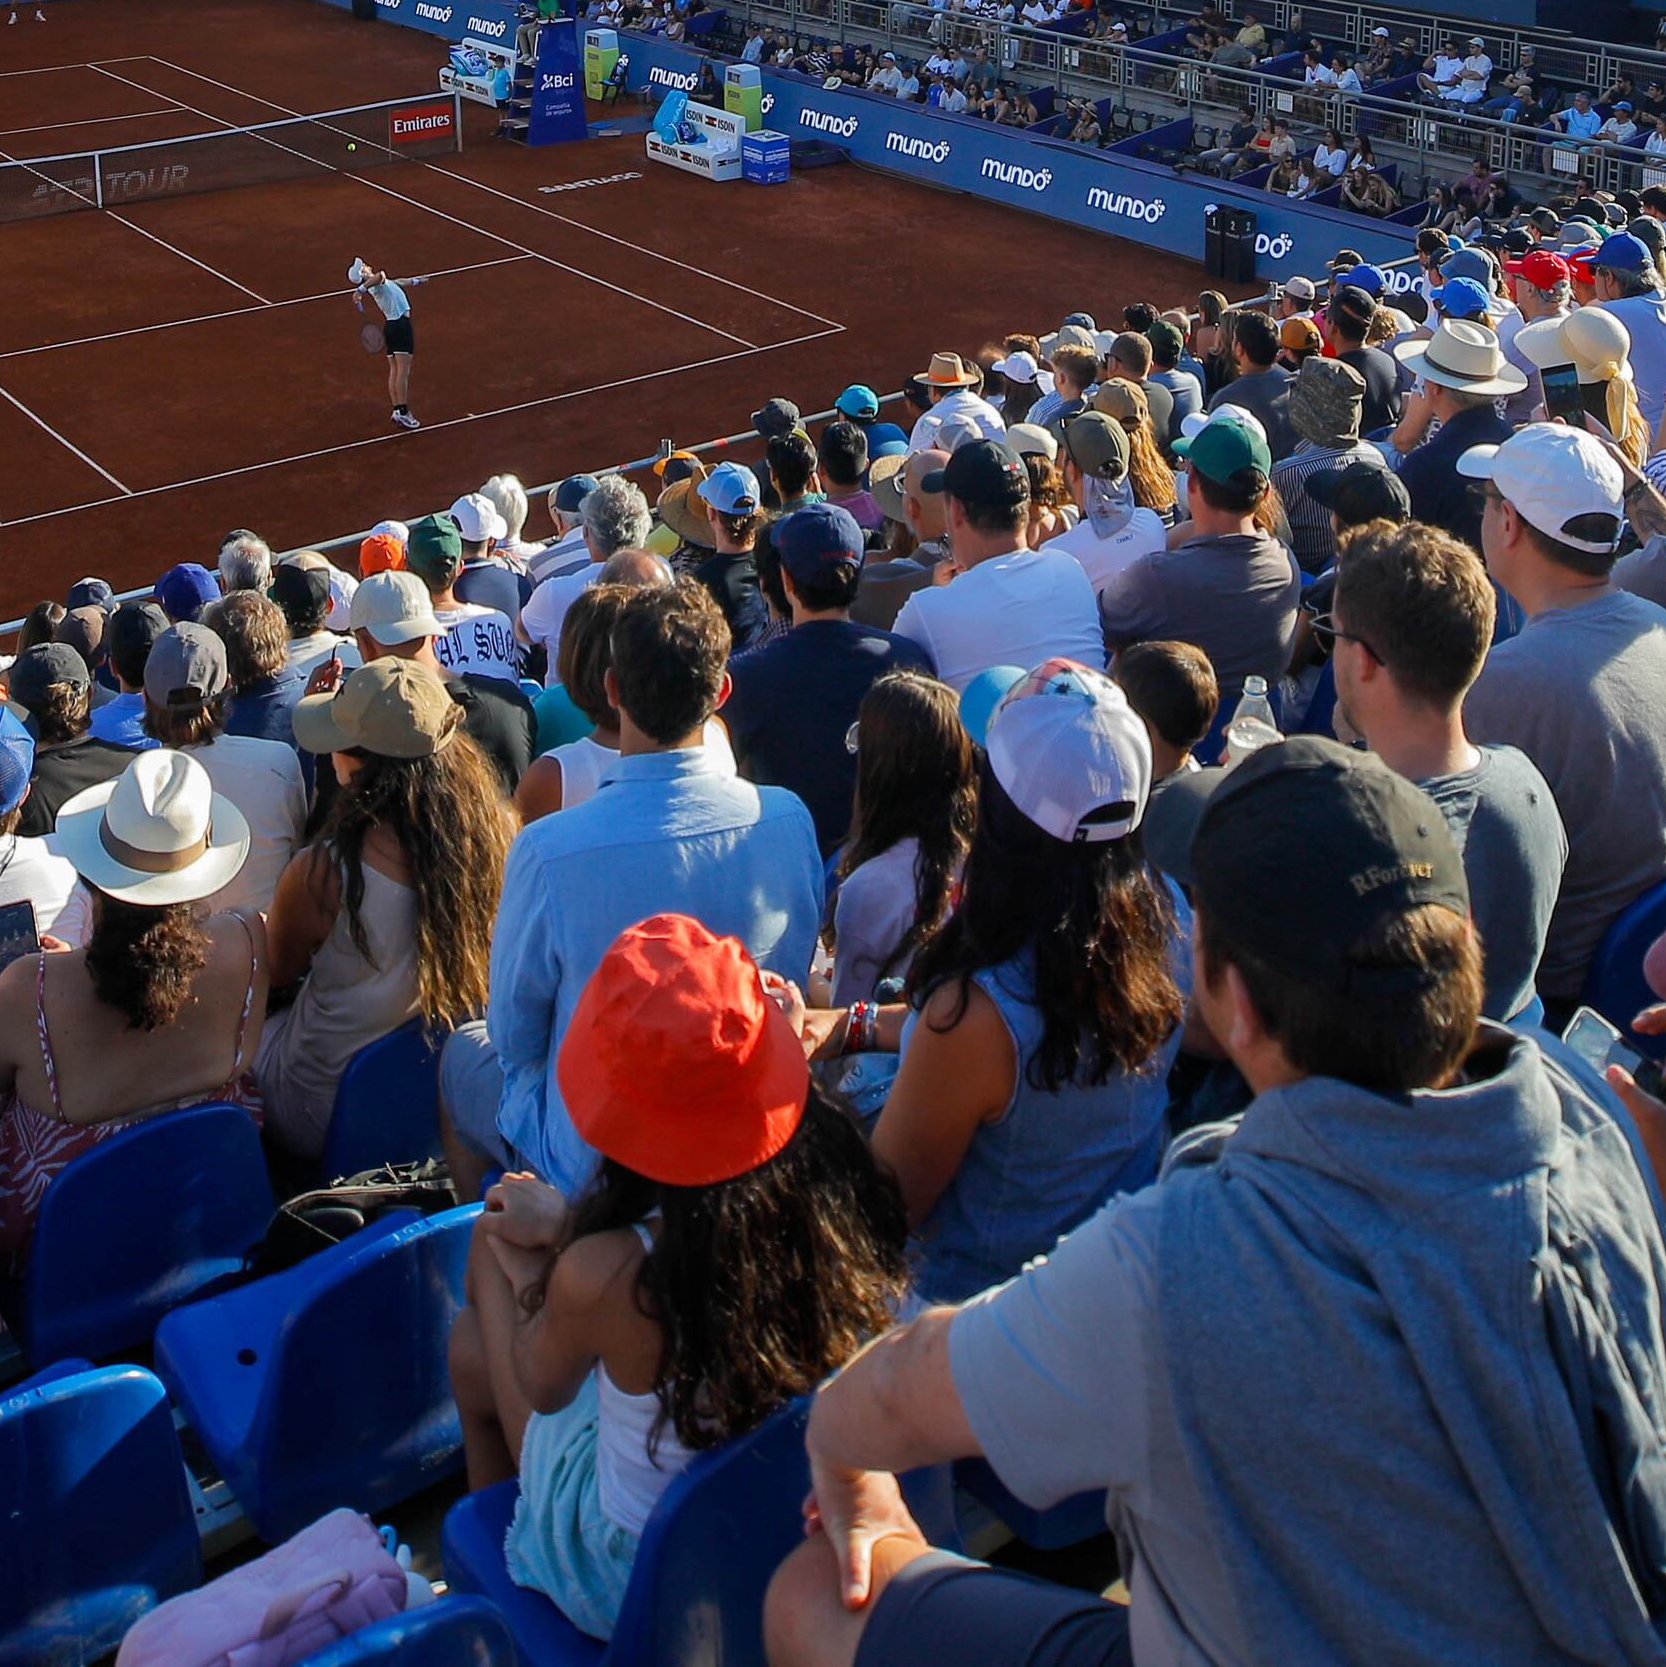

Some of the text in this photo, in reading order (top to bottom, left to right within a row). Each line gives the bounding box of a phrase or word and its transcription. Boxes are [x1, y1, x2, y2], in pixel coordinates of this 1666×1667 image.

[554, 73, 573, 88] Bci
[393, 115, 450, 134] Emirates
[686, 109, 734, 134] ISDIN ISDIN
[661, 145, 709, 170] ISDIN ISDIN
[106, 166, 189, 198] TOUR
[538, 172, 643, 194] SANTIAGO
[1230, 220, 1236, 231] 2
[1245, 222, 1251, 232] 2
